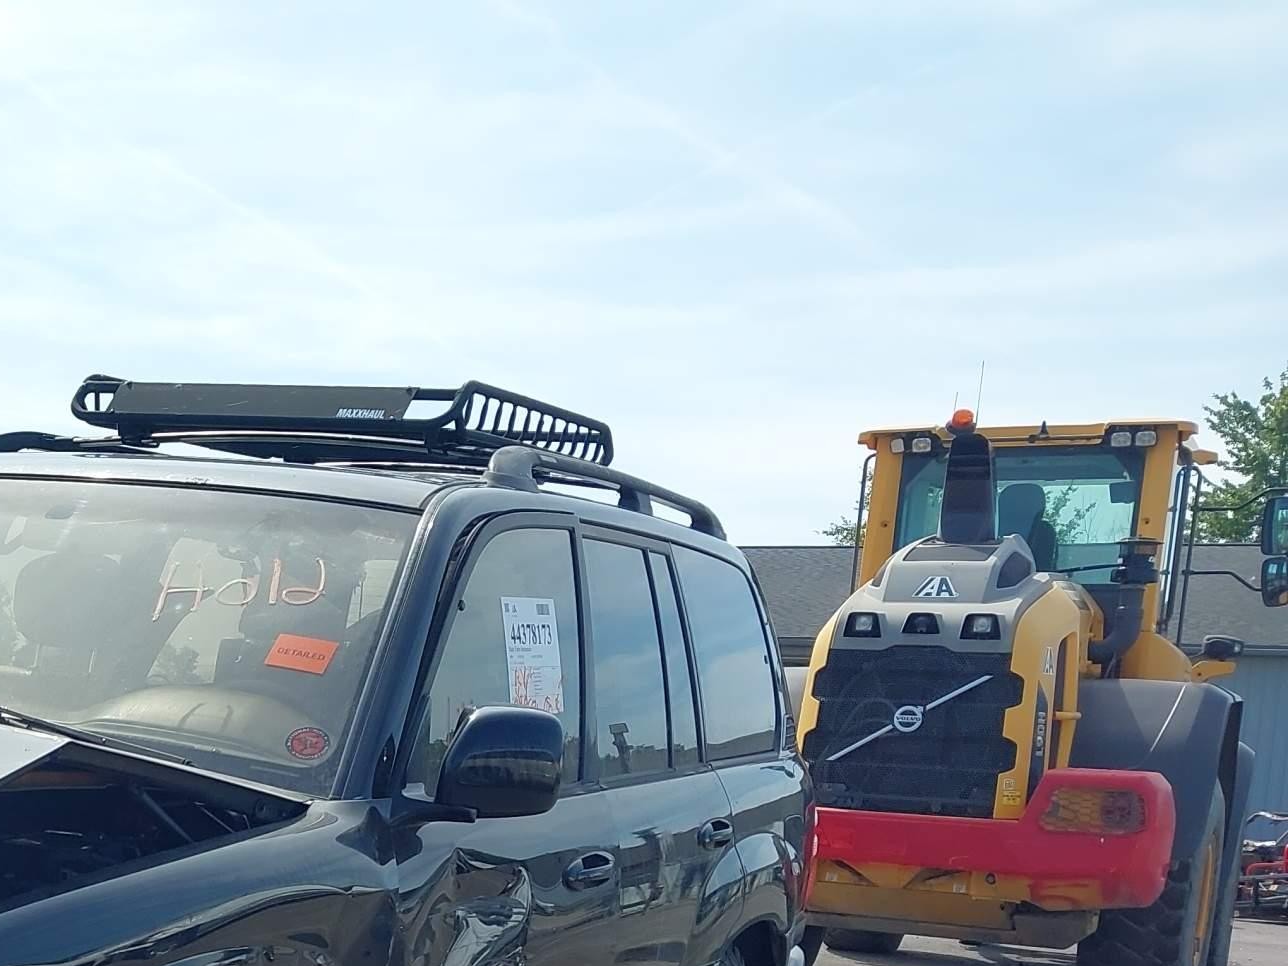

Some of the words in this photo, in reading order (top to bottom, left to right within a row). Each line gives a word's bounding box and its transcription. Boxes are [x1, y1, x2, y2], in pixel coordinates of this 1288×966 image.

[336, 409, 385, 419] MAXXHAUL
[511, 623, 552, 645] 44378173
[276, 645, 327, 661] DETAILED
[1035, 710, 1047, 758] L90H
